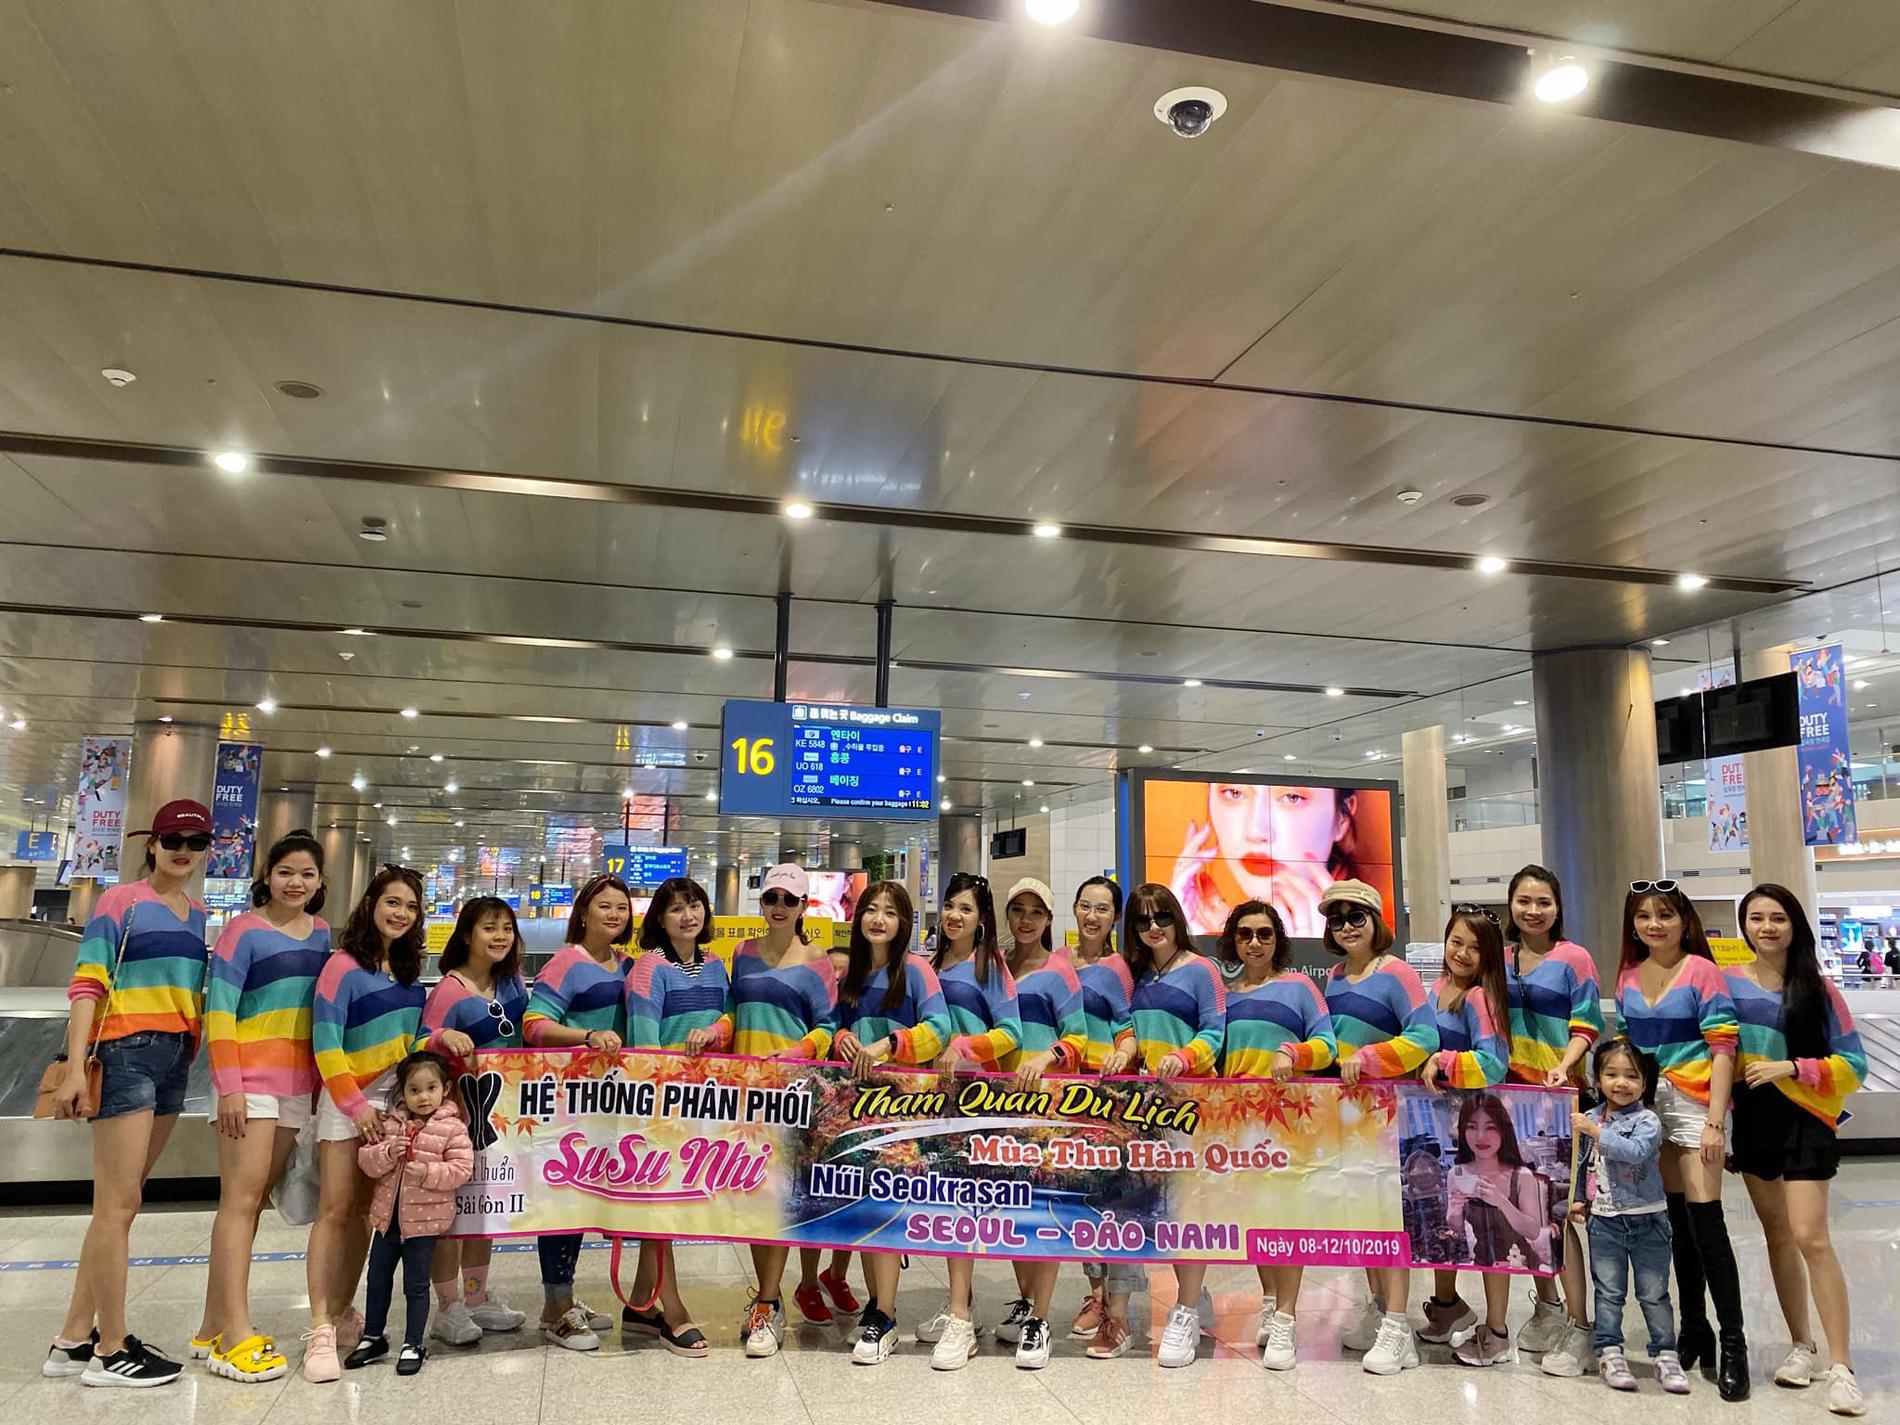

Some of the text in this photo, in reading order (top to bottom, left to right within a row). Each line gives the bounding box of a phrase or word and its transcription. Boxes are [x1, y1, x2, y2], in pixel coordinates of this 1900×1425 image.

[850, 710, 892, 724] Baggage
[892, 713, 919, 724] Claim
[1799, 711, 1828, 727] DUTY
[1800, 724, 1830, 738] FREE
[795, 739, 807, 748] KE
[731, 737, 775, 776] 16
[795, 761, 824, 771] UO 618
[1721, 762, 1744, 775] DUT
[829, 774, 860, 787] 베이징
[1722, 773, 1743, 785] FRE
[216, 785, 243, 794] DUTY
[793, 784, 825, 794] OZ 6802
[215, 793, 243, 802] FREE
[884, 800, 908, 808] baggage
[93, 810, 121, 819] DUTY
[92, 818, 121, 827] FREE
[607, 858, 625, 873] 17
[520, 1070, 811, 1129] HỆ THỐNG PHÂN PHỐI
[851, 1081, 1200, 1135] Tham Quan Du Lịch
[968, 1133, 1290, 1176] Mùa Thu Hàn Quốc
[679, 1136, 773, 1193] Nhi
[870, 1169, 1032, 1209] Seokrasan
[455, 1193, 525, 1215] Sài Gòn II
[906, 1213, 1027, 1248] SEOUL
[1071, 1211, 1146, 1251] ĐẢO
[1155, 1222, 1241, 1251] NAMI
[1256, 1236, 1400, 1257] Ngày 08-12/10/2019
